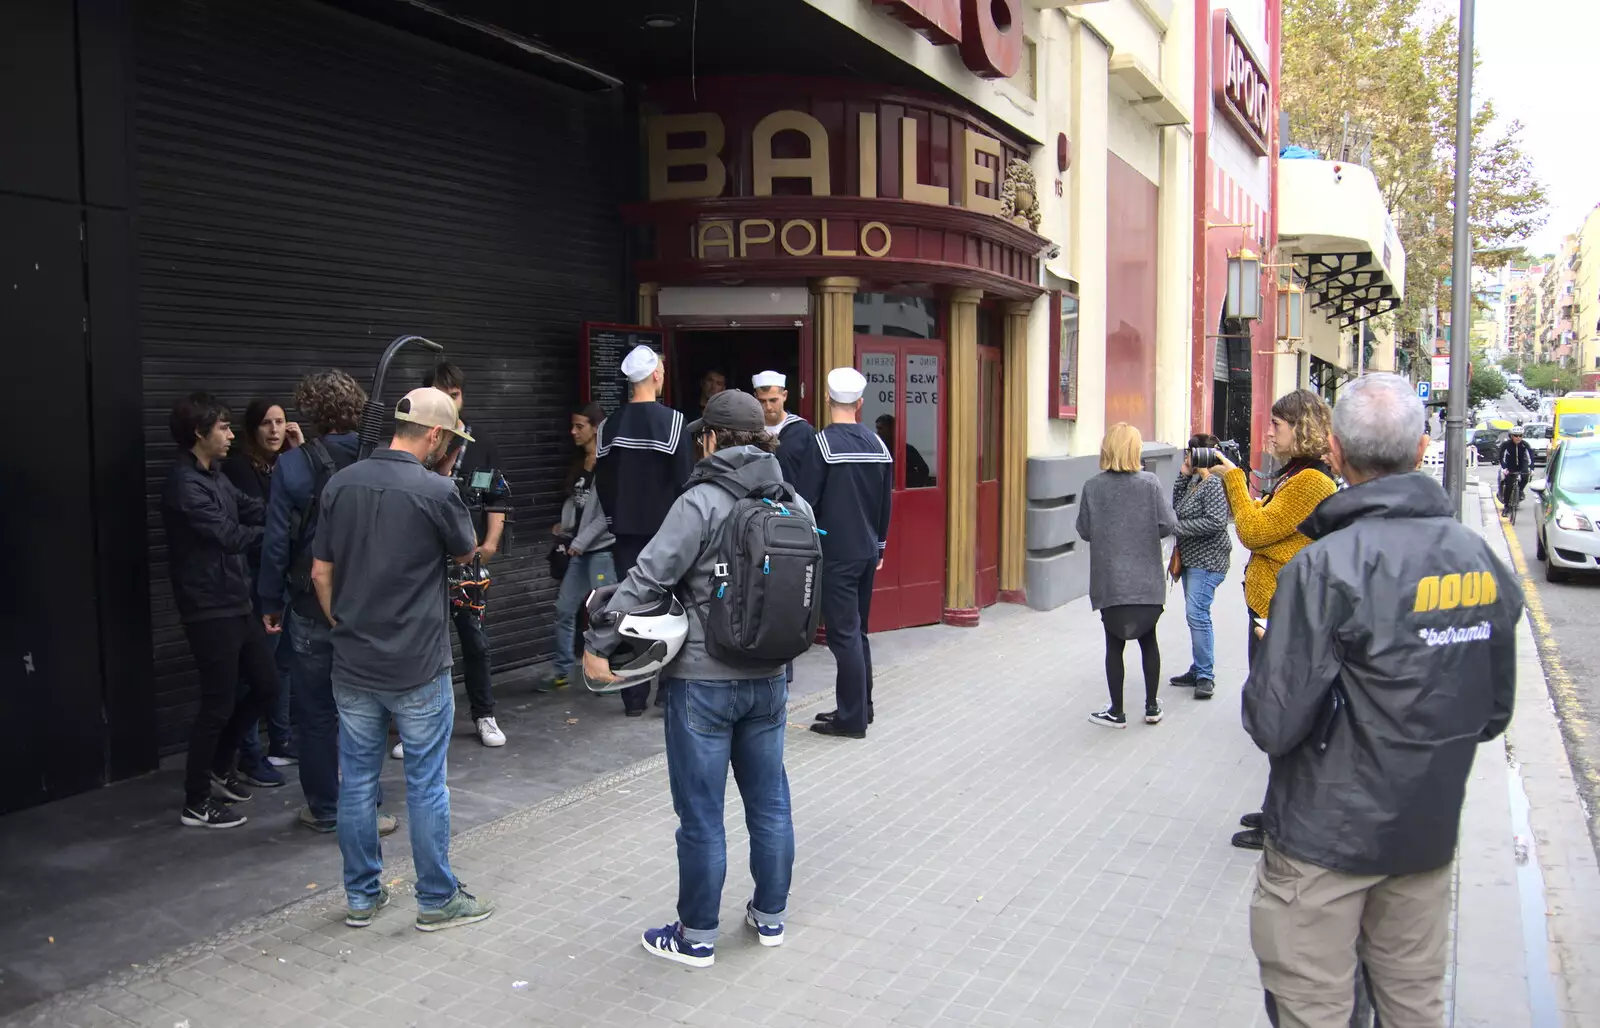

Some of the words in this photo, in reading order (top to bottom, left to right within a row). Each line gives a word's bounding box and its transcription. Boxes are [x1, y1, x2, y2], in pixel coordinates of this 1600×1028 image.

[1227, 33, 1268, 136] APOLO
[648, 109, 1001, 216] BAILE
[698, 217, 892, 259] APOLO
[803, 563, 813, 607] THULE
